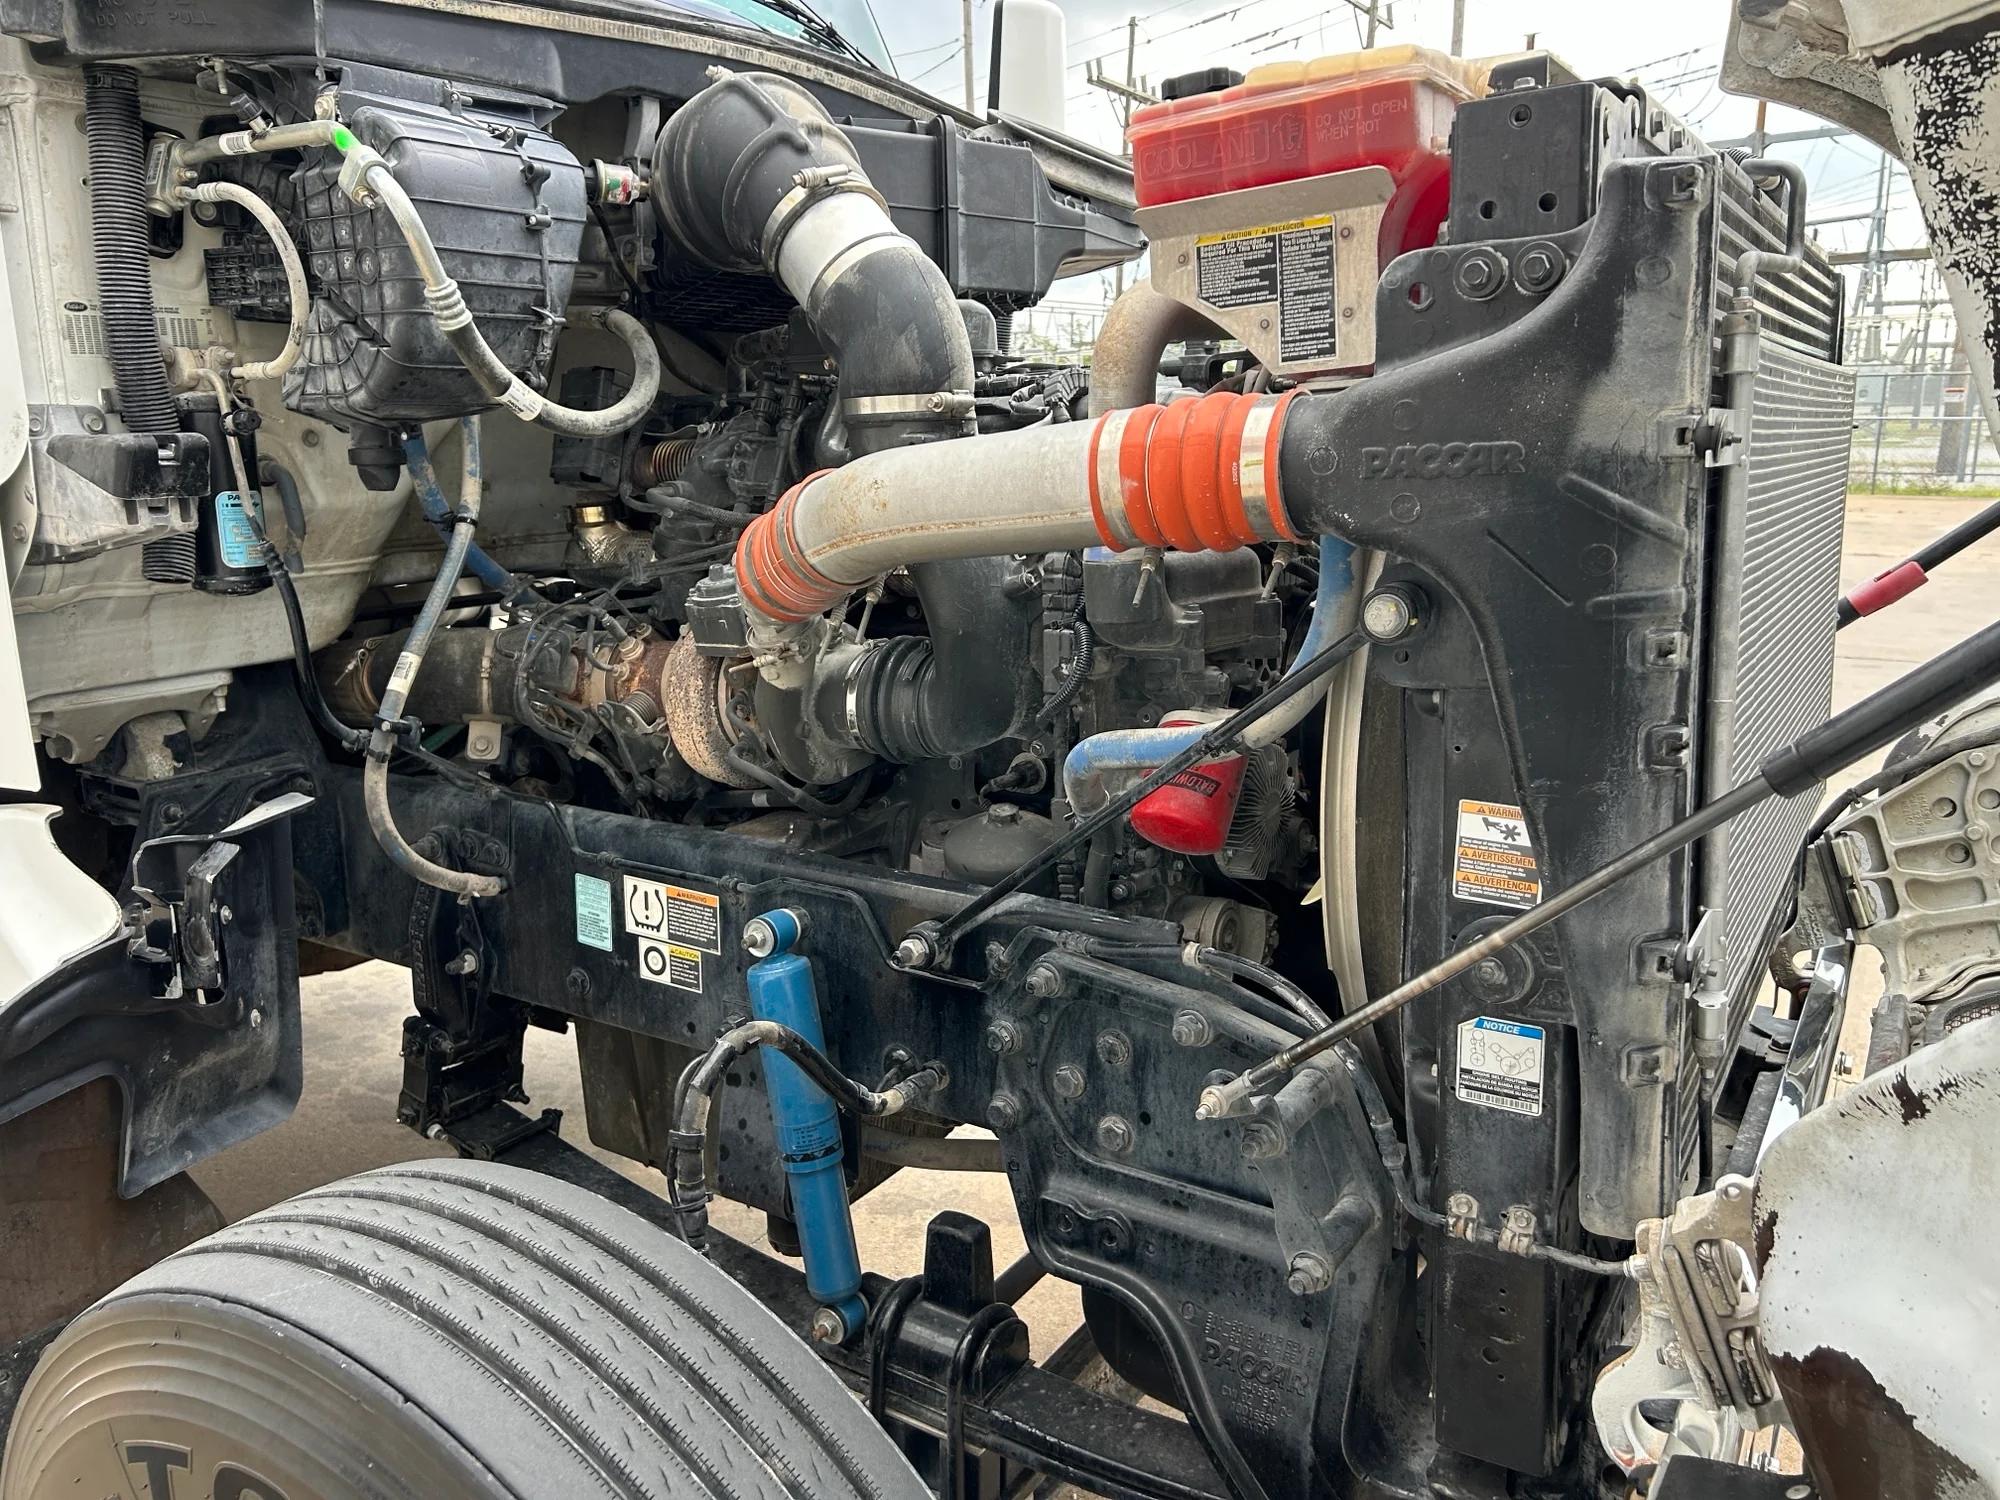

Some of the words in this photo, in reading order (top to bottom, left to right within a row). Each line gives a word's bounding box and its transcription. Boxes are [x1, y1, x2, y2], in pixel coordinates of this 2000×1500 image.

[97, 13, 117, 26] DO
[1315, 113, 1333, 128] DO
[1339, 106, 1363, 123] NOT
[1372, 98, 1408, 115] OPEN
[1356, 118, 1382, 135] HOT
[1142, 128, 1262, 178] COOLANT
[1226, 229, 1252, 240] CAUTION
[1362, 441, 1526, 480] PACCAR
[1170, 773, 1217, 794] BALDWI
[1488, 806, 1523, 819] WARNIN
[1471, 850, 1534, 867] AVERTISSEMEN
[1474, 875, 1533, 892] ADVERTENCIA
[1482, 1020, 1521, 1034] NOTICE
[1201, 1336, 1309, 1398] PACCAR
